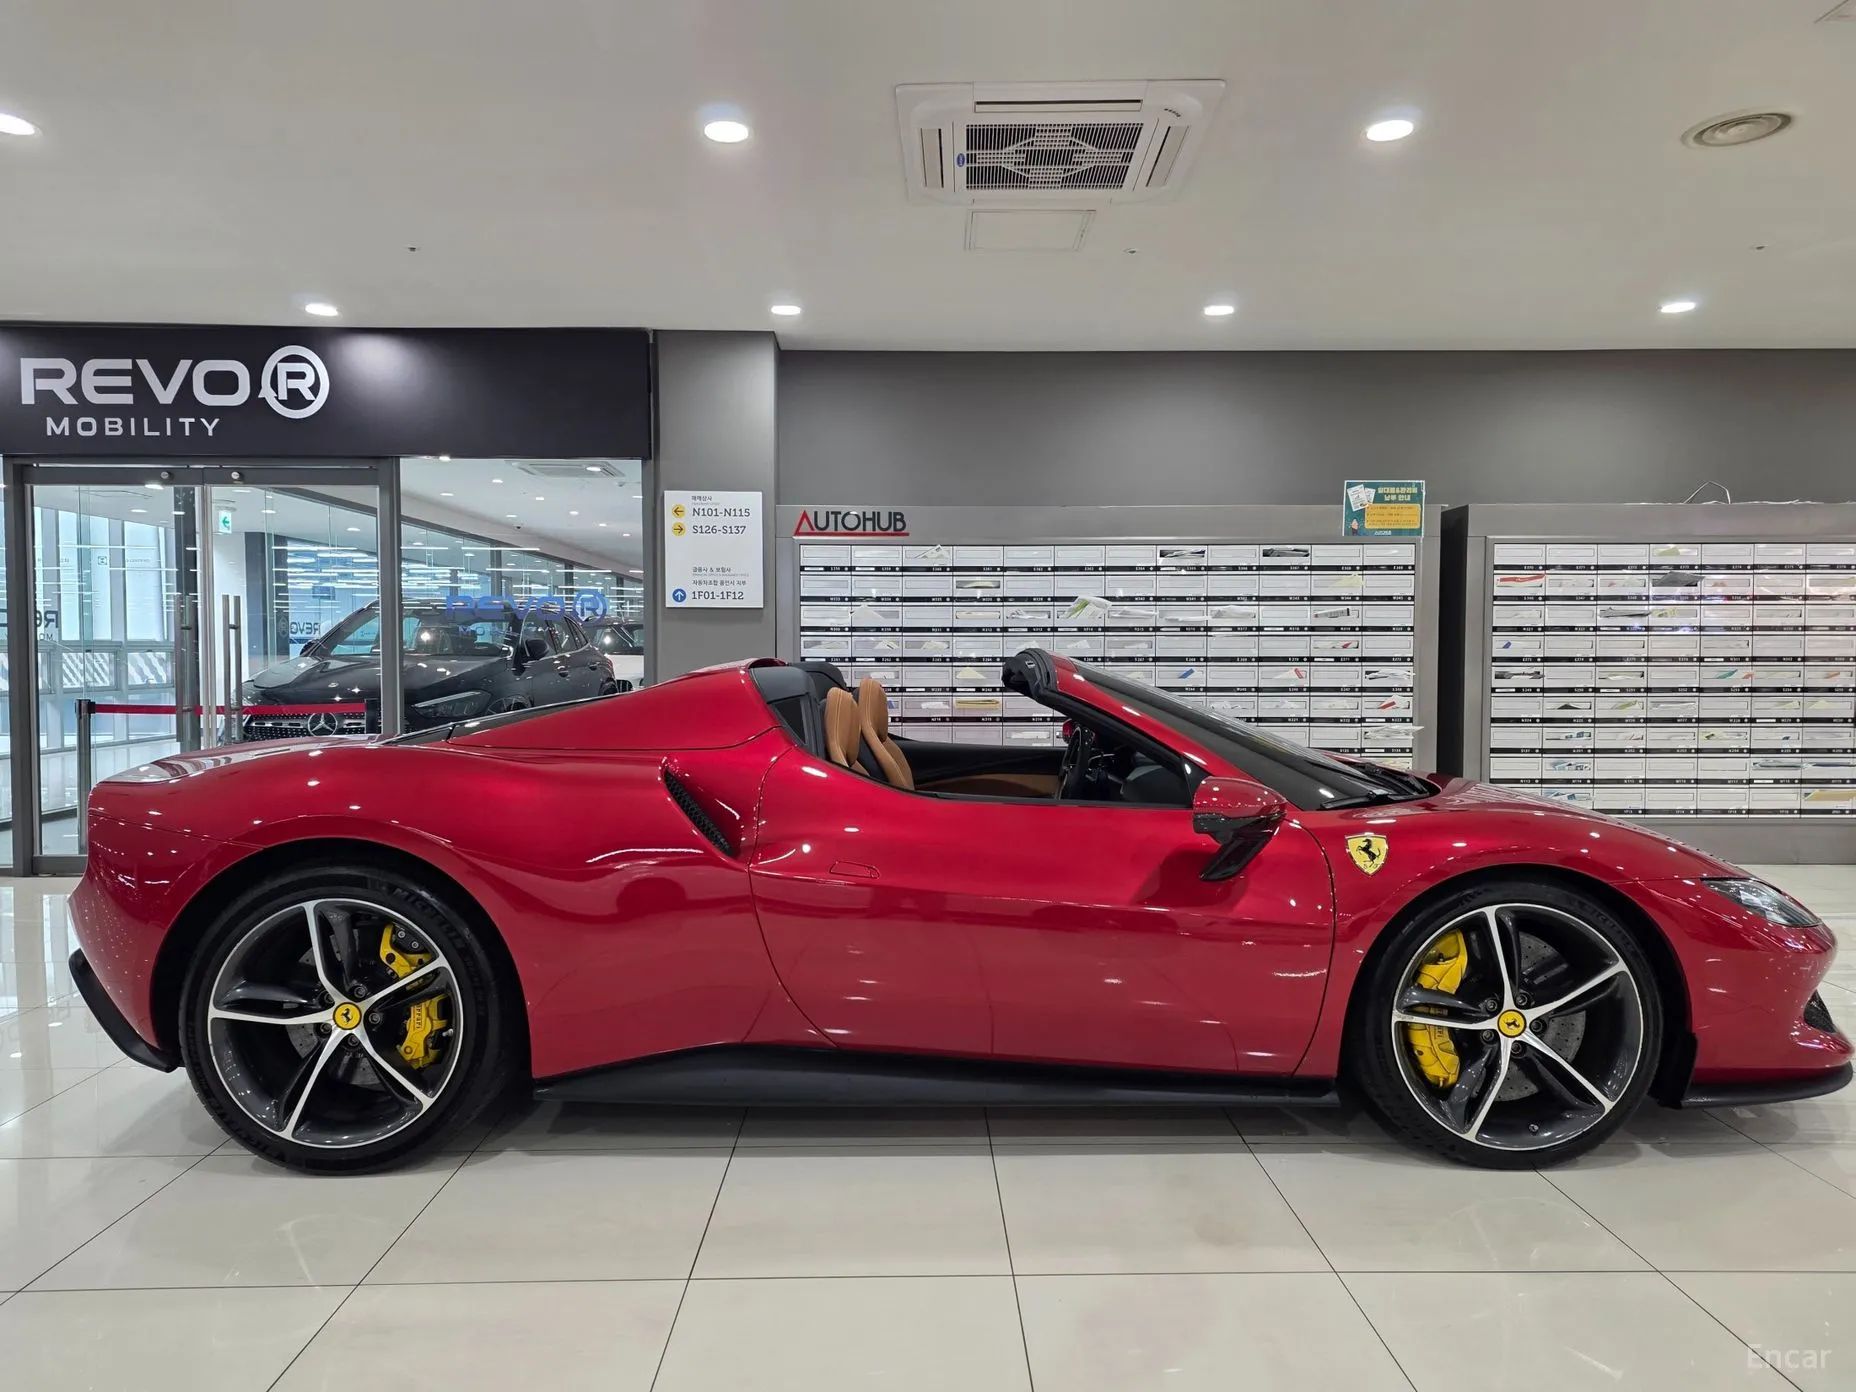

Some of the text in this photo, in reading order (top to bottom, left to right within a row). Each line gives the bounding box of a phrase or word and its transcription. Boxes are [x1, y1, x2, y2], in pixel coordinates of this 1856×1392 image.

[20, 358, 250, 406] REVO
[46, 417, 220, 437] MOBILITY
[692, 507, 751, 518] N101-N115
[794, 510, 907, 533] AUTOHUB
[692, 525, 747, 535] S126-S137
[692, 590, 744, 600] 1F01-1F12
